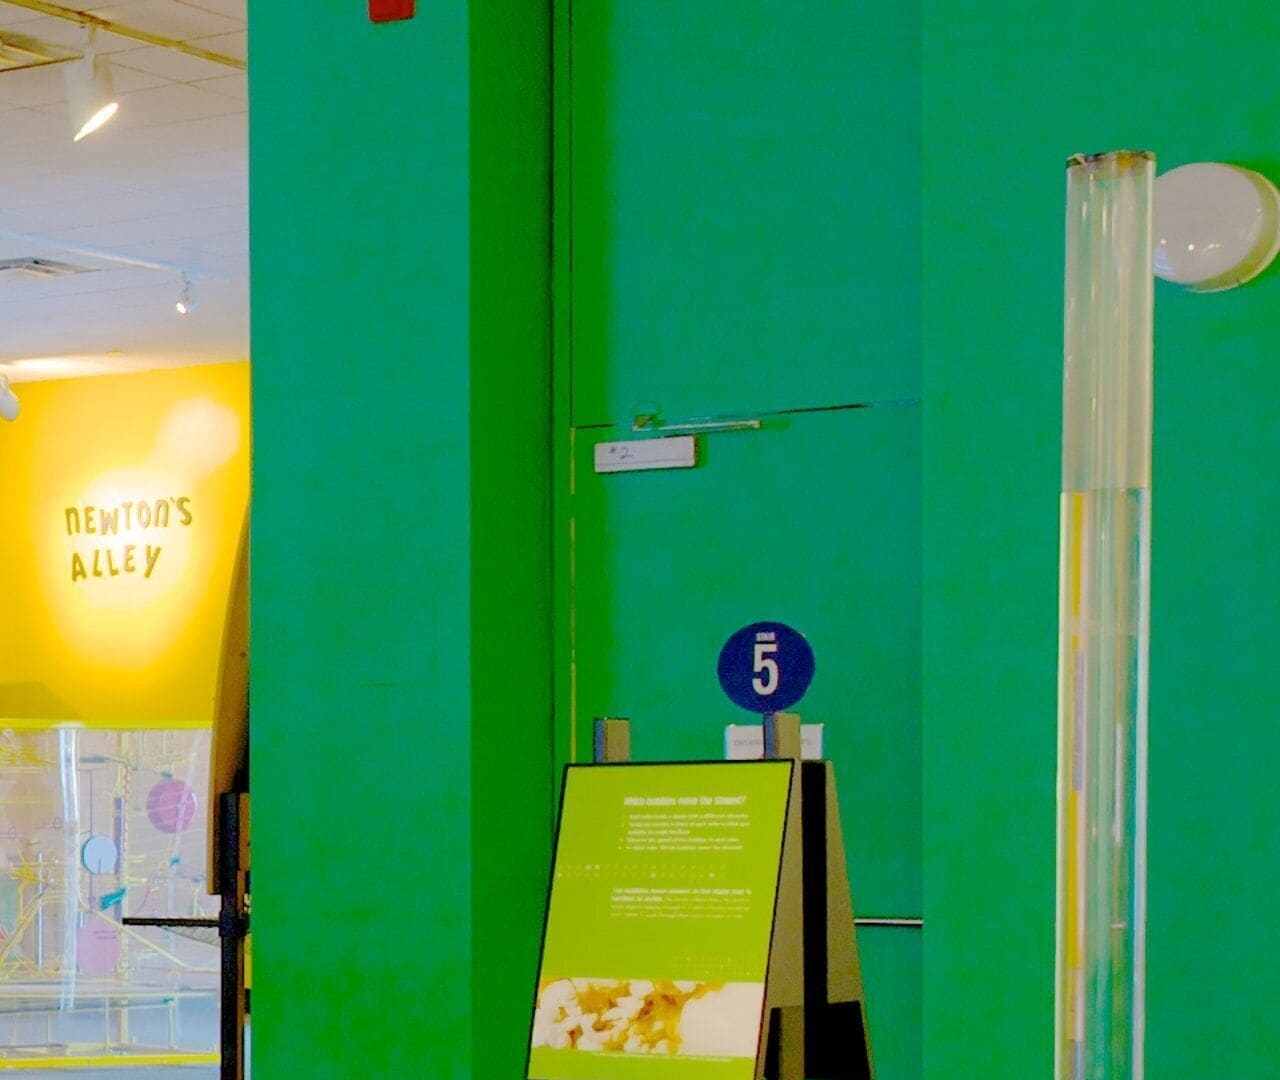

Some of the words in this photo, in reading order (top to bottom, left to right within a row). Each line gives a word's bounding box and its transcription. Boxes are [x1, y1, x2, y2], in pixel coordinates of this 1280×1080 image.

[65, 496, 193, 535] NEWTON'S
[71, 545, 161, 583] ALLEY
[752, 643, 779, 695] 5
